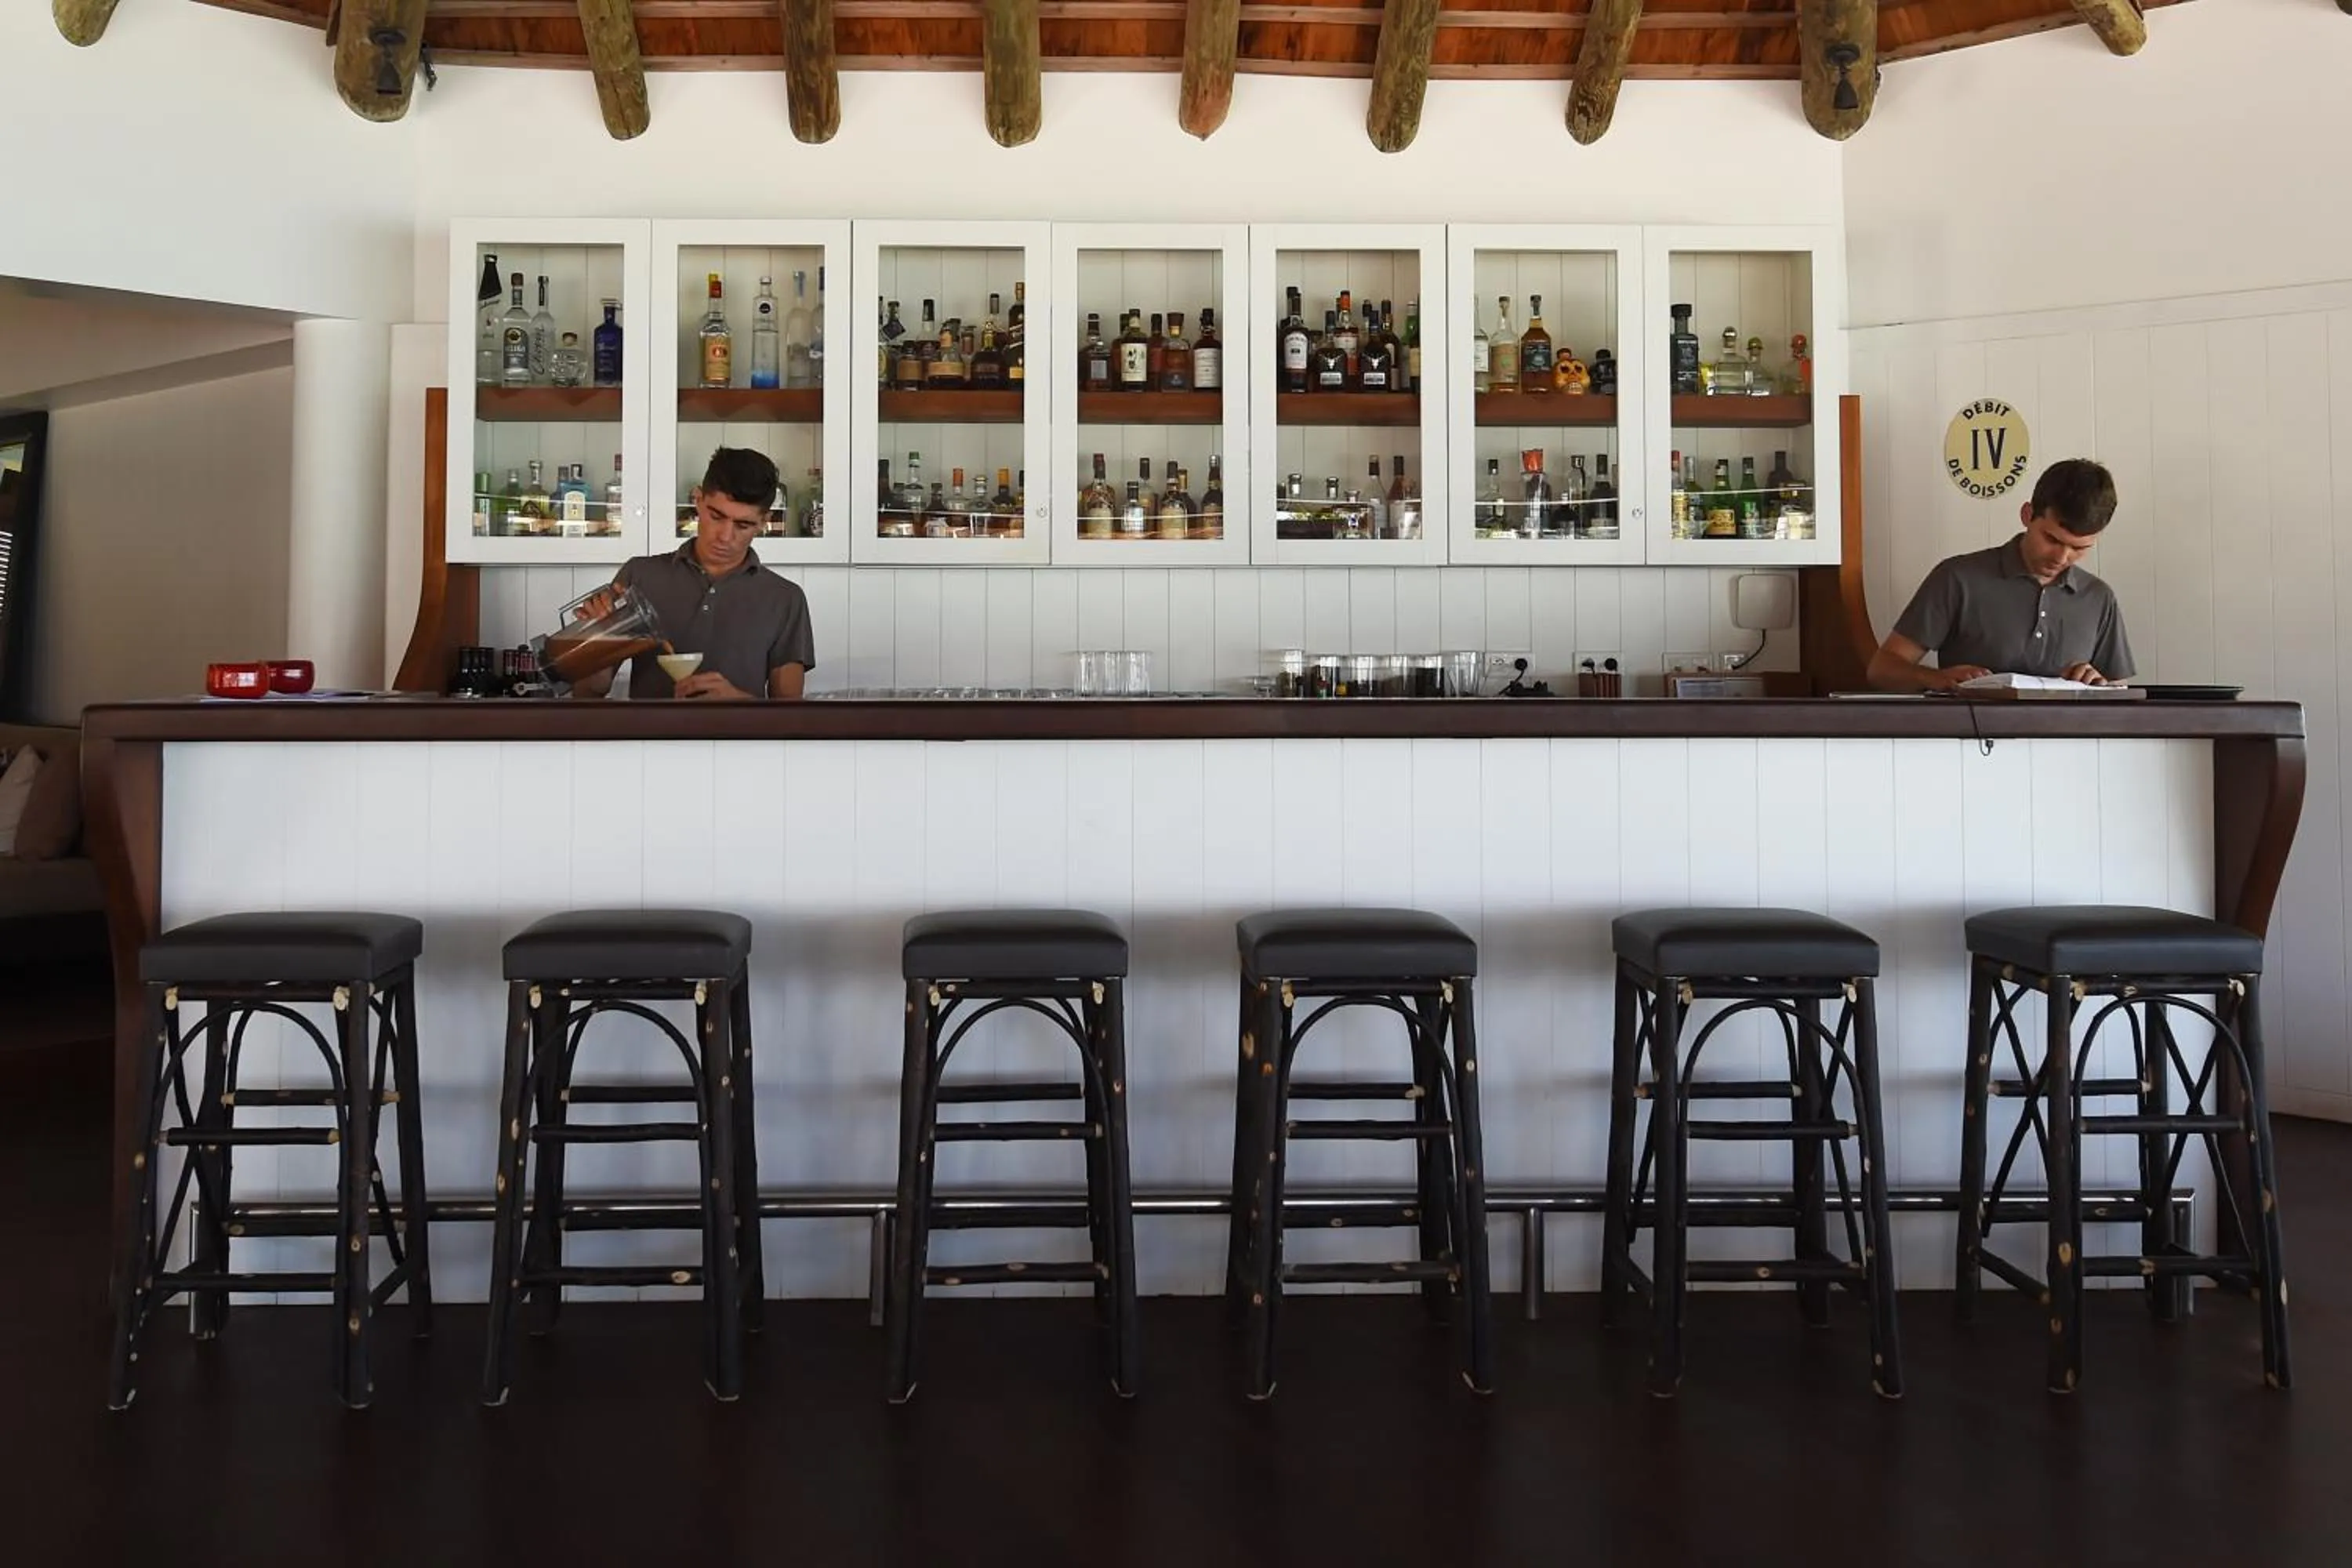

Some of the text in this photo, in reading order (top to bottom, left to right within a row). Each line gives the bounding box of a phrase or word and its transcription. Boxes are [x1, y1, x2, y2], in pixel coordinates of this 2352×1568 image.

[1971, 427, 2007, 470] IV
[1948, 456, 2027, 496] DE BOISSONS
